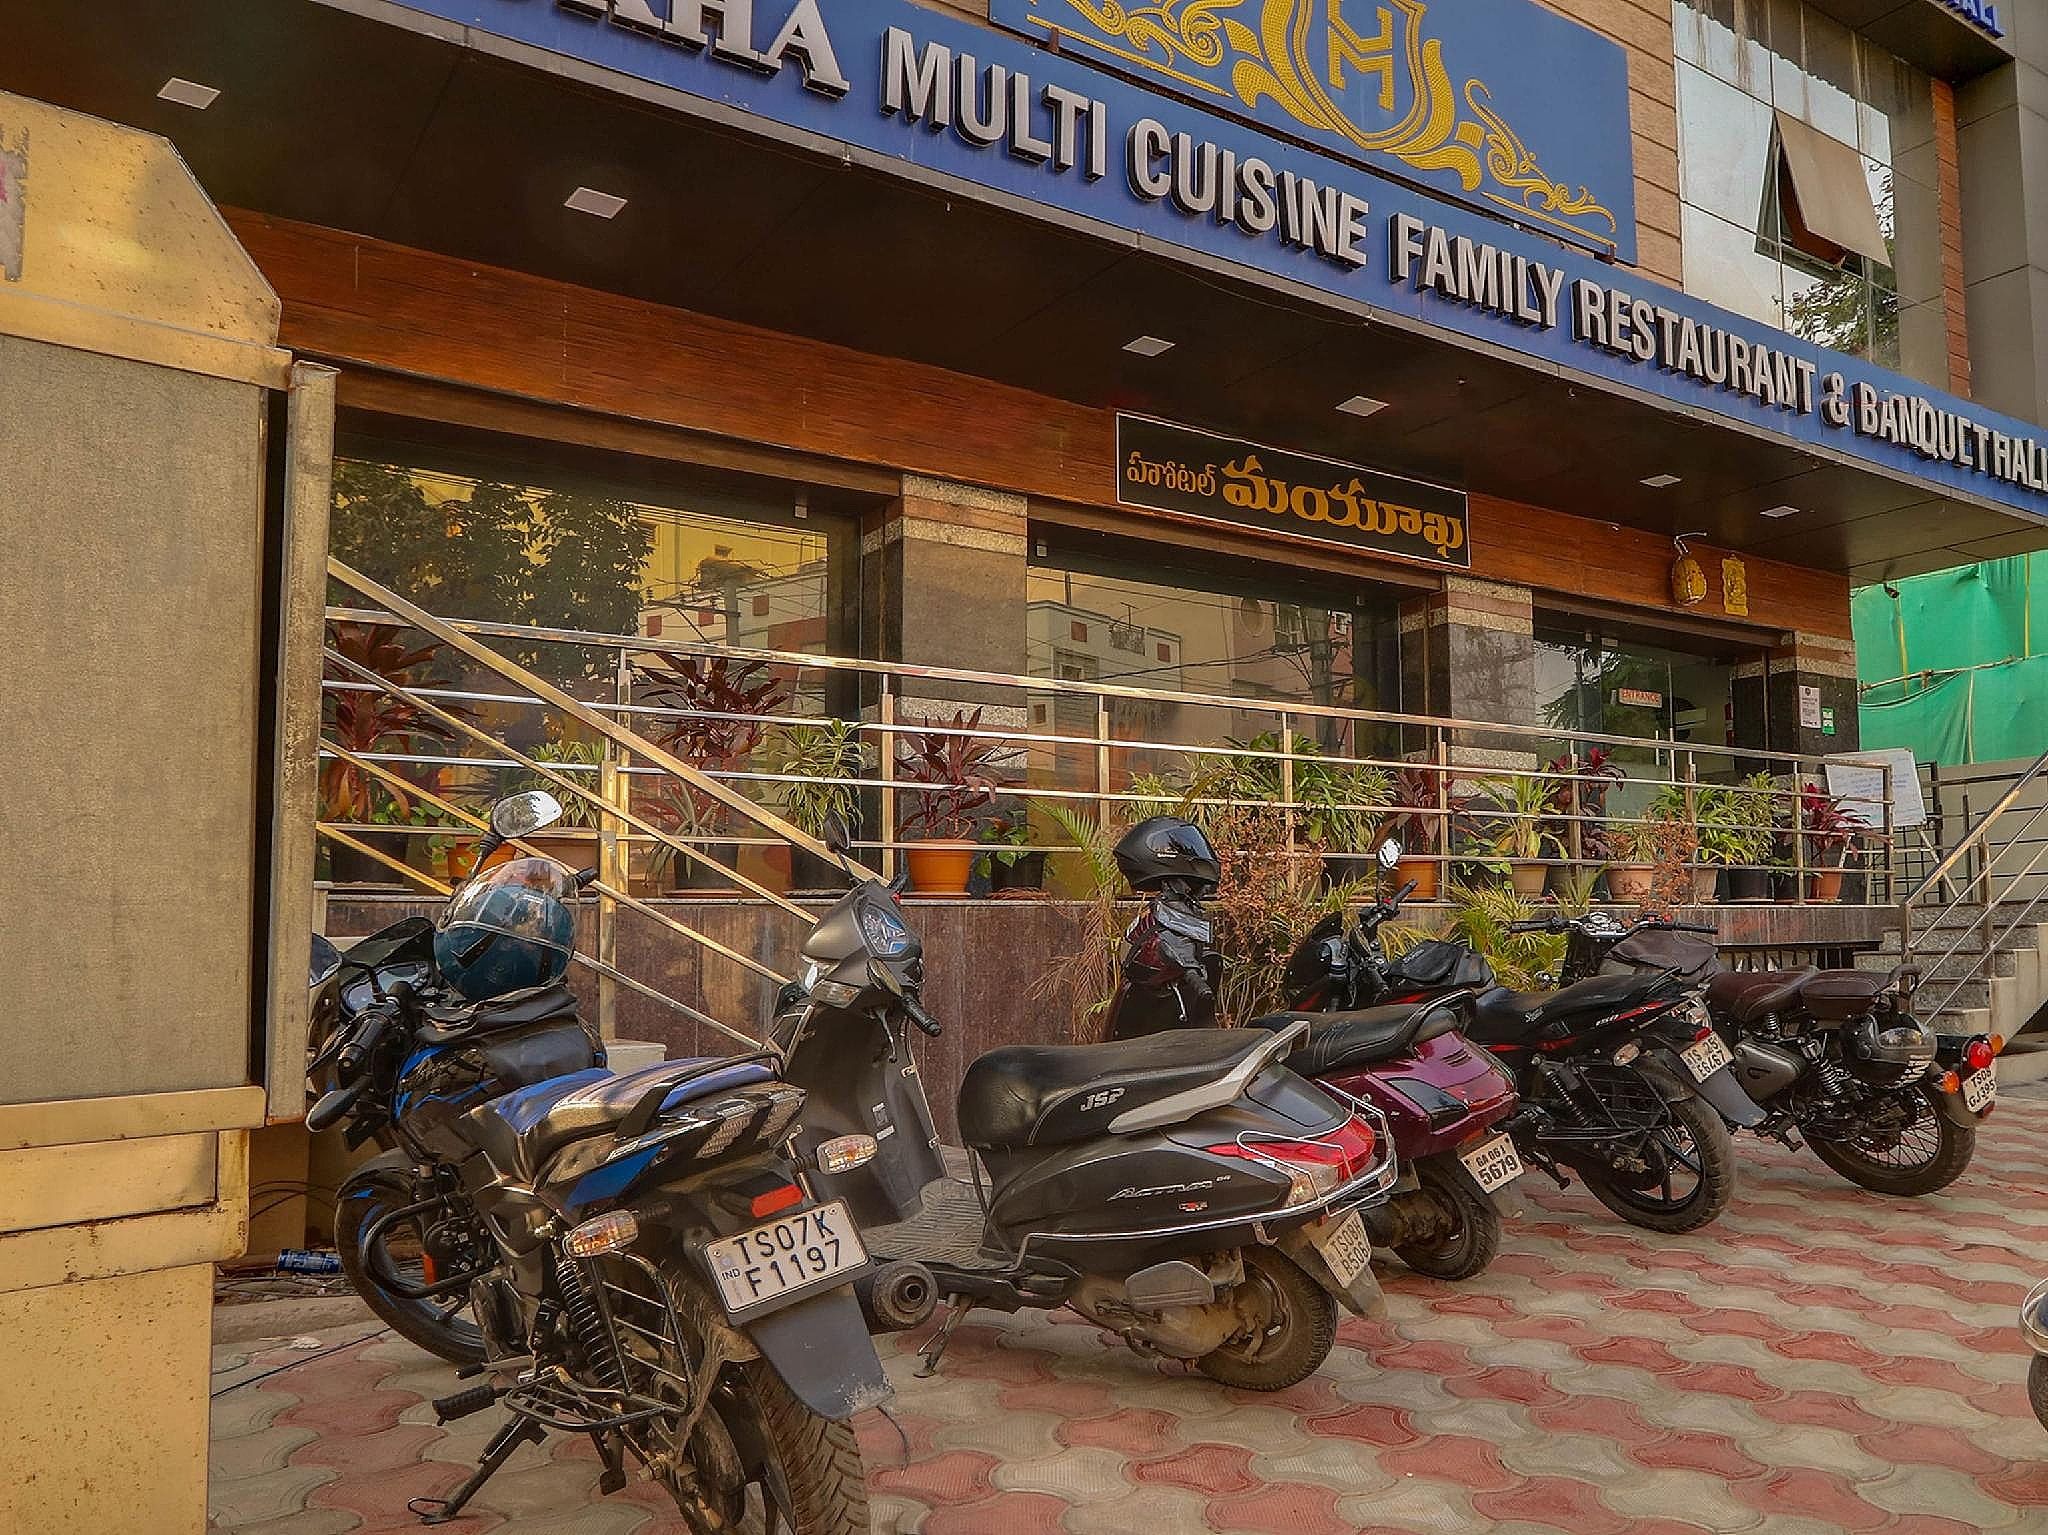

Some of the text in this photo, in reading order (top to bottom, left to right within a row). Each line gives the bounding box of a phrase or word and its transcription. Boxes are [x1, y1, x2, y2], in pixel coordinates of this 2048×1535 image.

[880, 26, 1107, 181] MULTI
[1126, 118, 1369, 270] CUISINE
[1388, 212, 1565, 328] FAMILY
[1571, 279, 1815, 415] RESTAURANT
[1821, 371, 1851, 428] &
[1478, 1154, 1519, 1186] 5679
[732, 1210, 835, 1266] TS07K
[721, 1267, 741, 1282] IND
[745, 1238, 840, 1297] F1197
